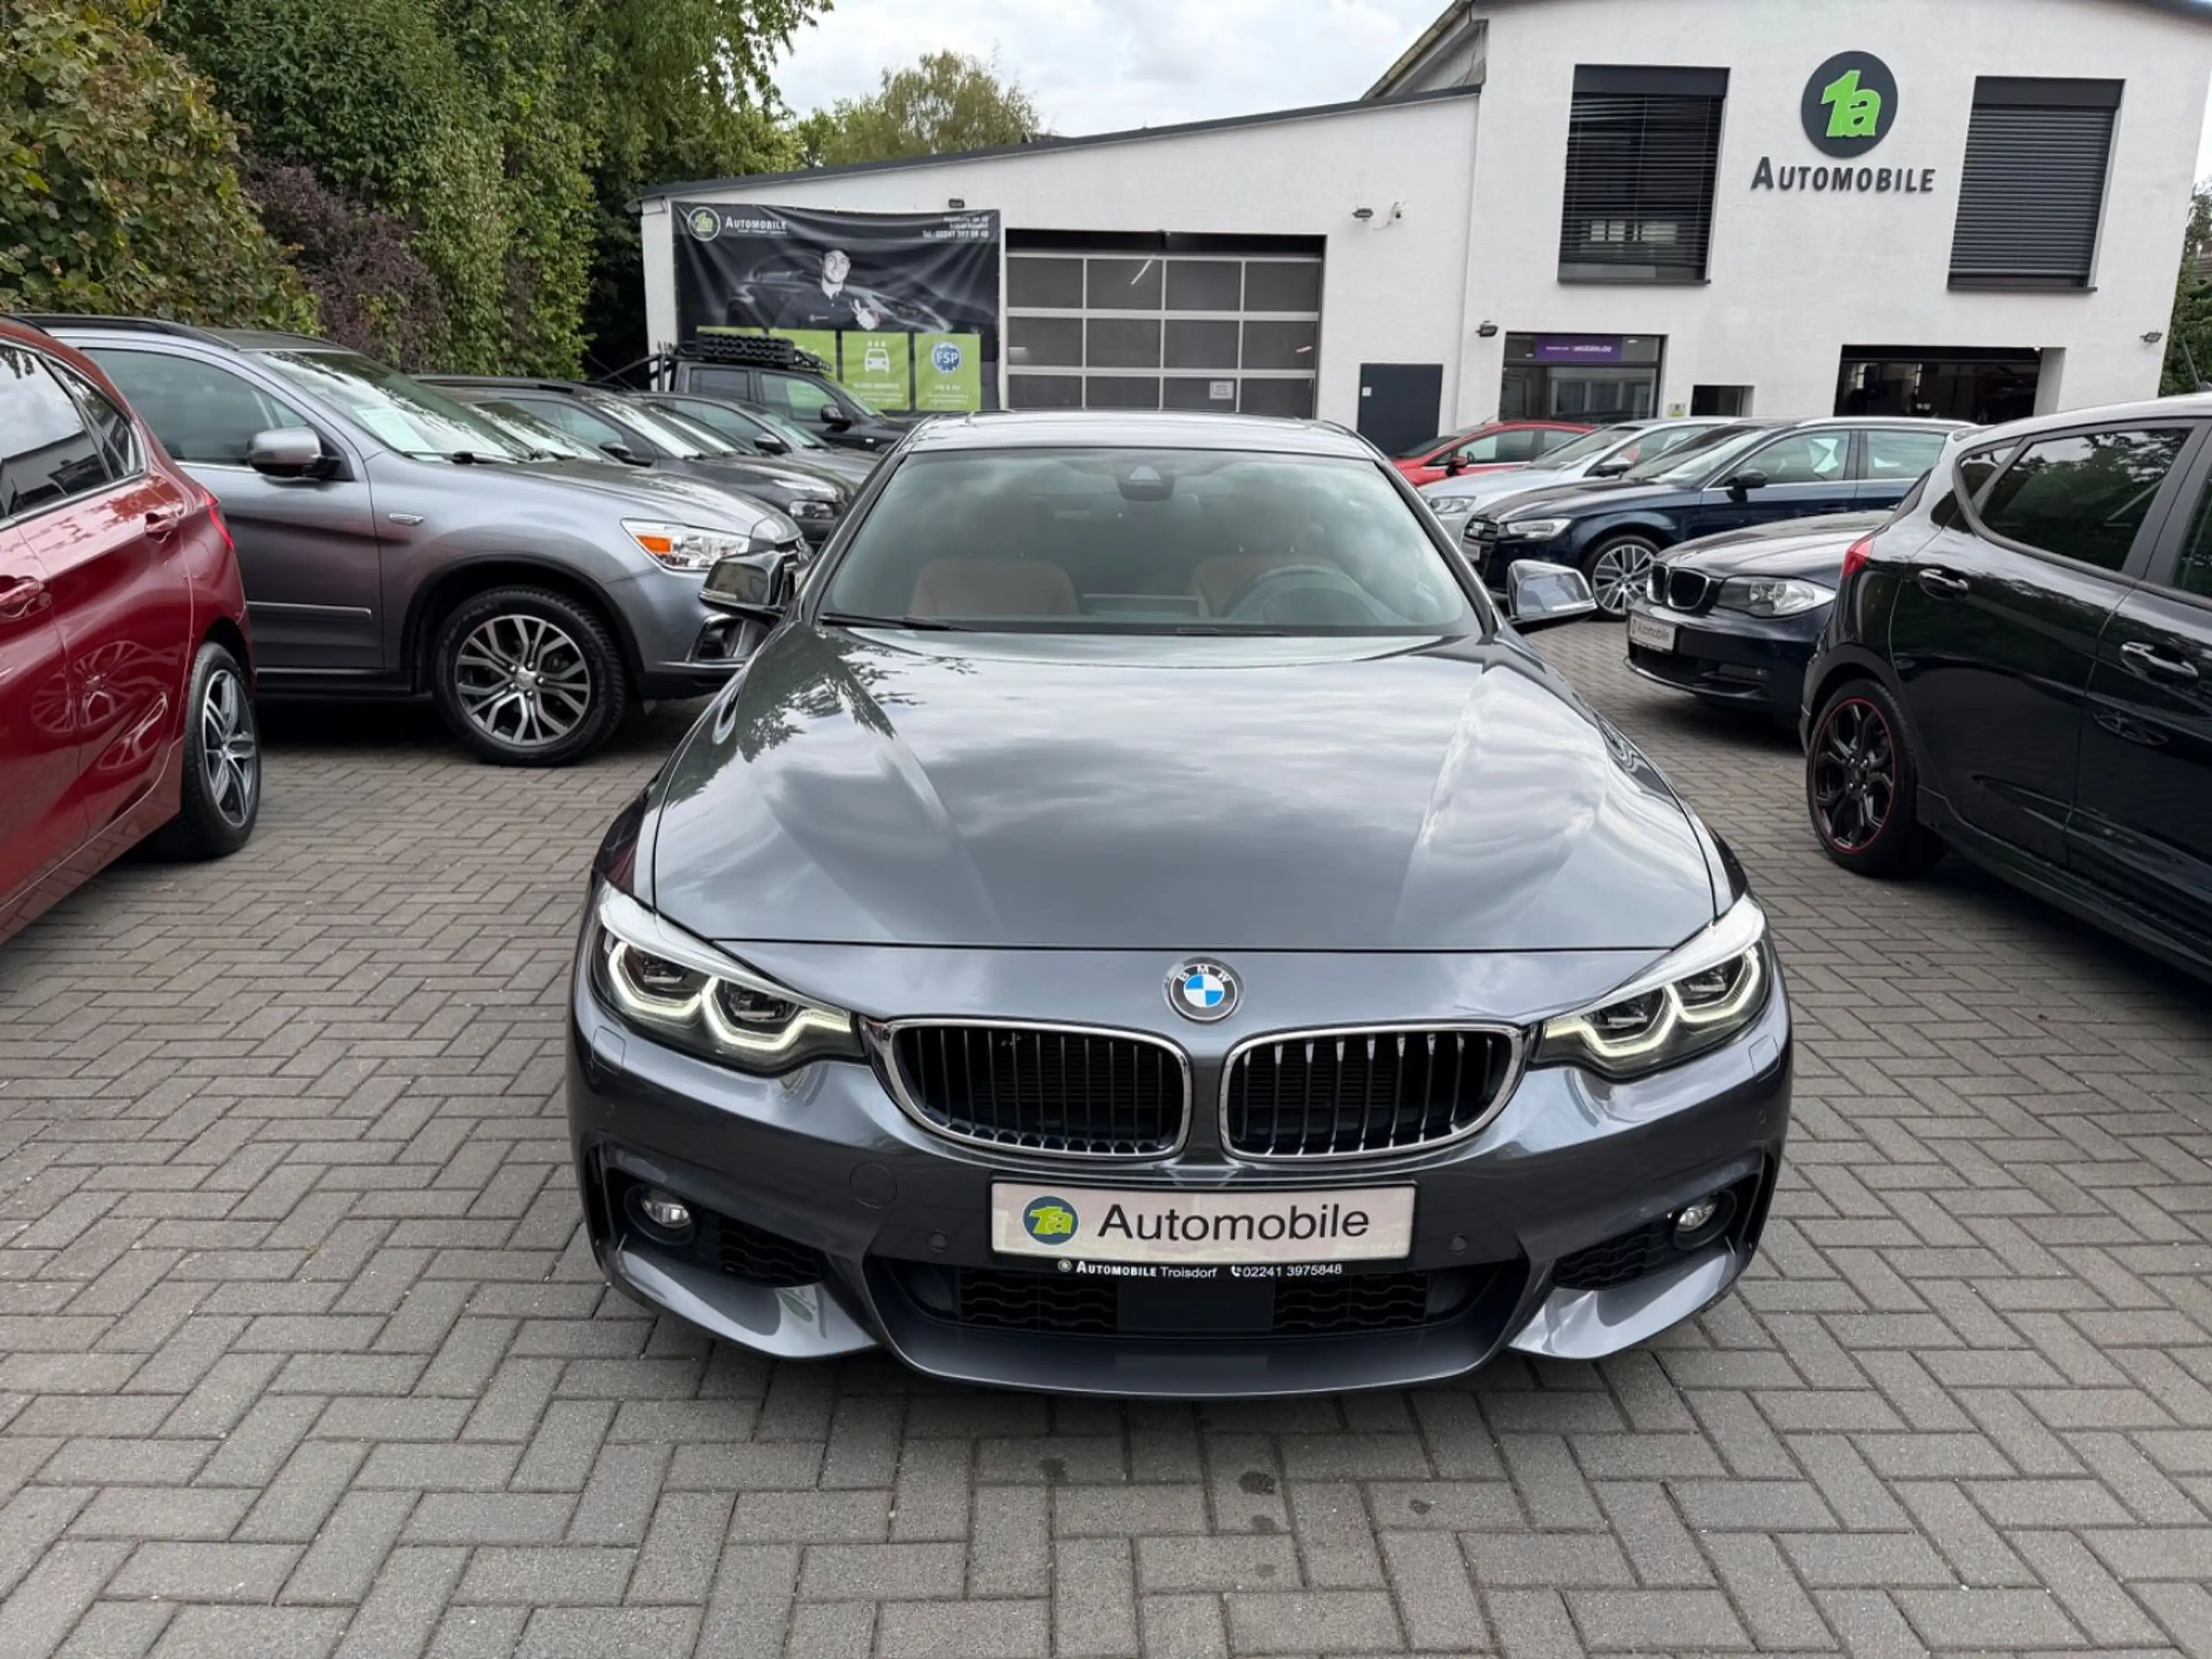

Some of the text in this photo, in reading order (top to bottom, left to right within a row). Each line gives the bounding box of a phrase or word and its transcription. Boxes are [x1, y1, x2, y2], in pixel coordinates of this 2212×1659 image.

[1820, 70, 1881, 138] 1a
[937, 352, 958, 364] FSP
[1029, 1203, 1369, 1240] 1a Automobile
[1161, 1266, 1217, 1278] Troisdorf
[1242, 1265, 1282, 1277] 02241
[1286, 1263, 1343, 1277] 3975848
